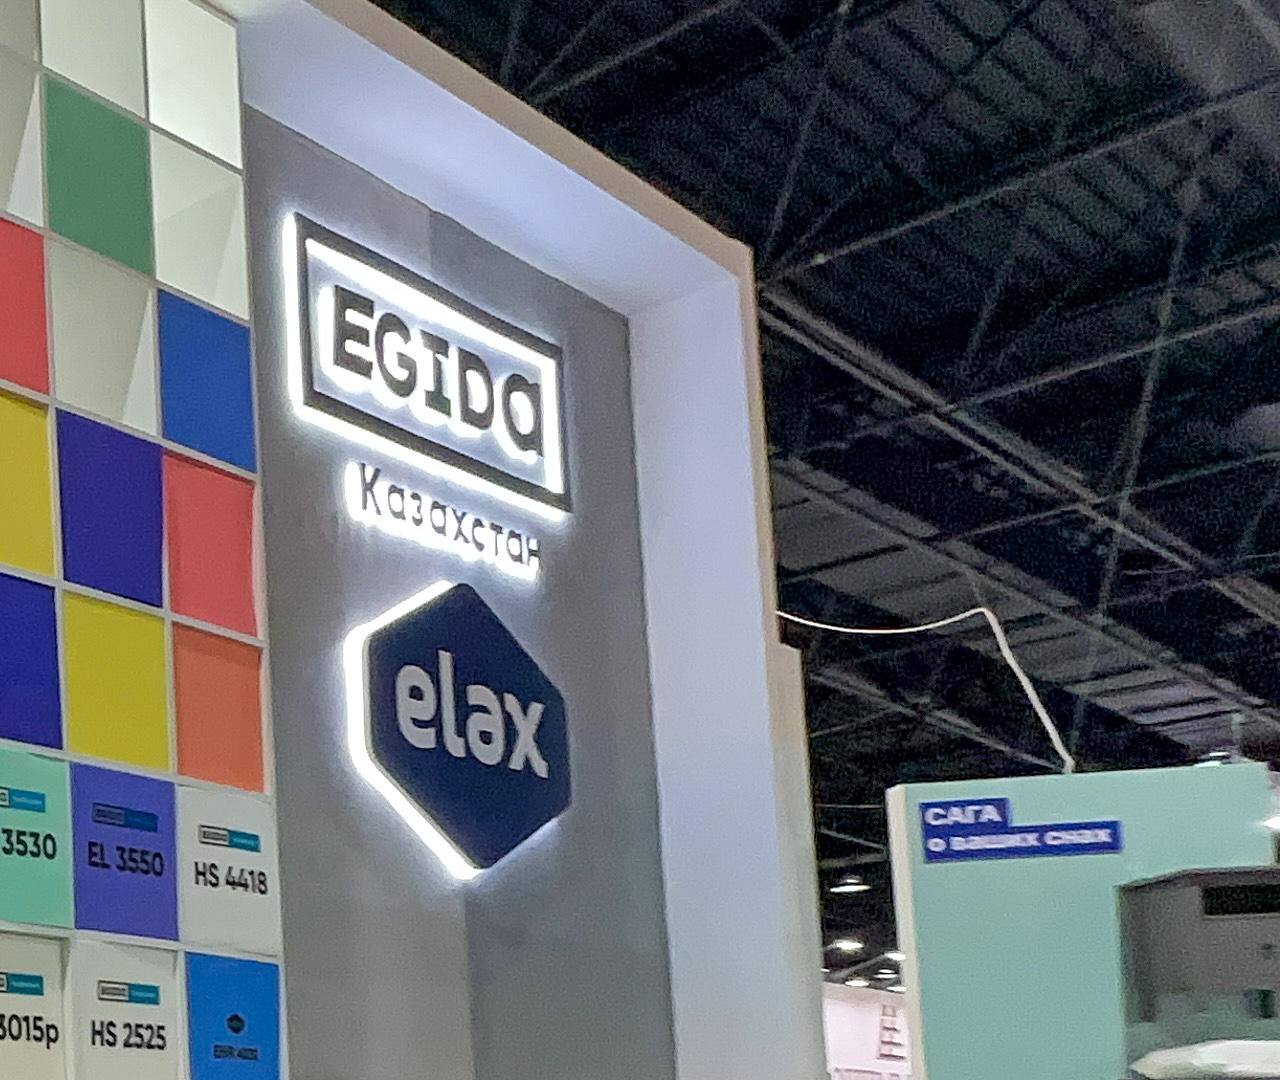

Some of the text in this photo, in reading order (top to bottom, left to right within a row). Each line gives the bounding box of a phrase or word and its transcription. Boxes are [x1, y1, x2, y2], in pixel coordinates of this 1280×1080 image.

[359, 461, 541, 568] Казахстан
[394, 650, 550, 778] elax
[924, 804, 1003, 826] САГА
[1, 828, 57, 860] 3530
[87, 841, 164, 877] EL 3550
[194, 861, 268, 895] HS 4418
[91, 1020, 167, 1051] HS 2525
